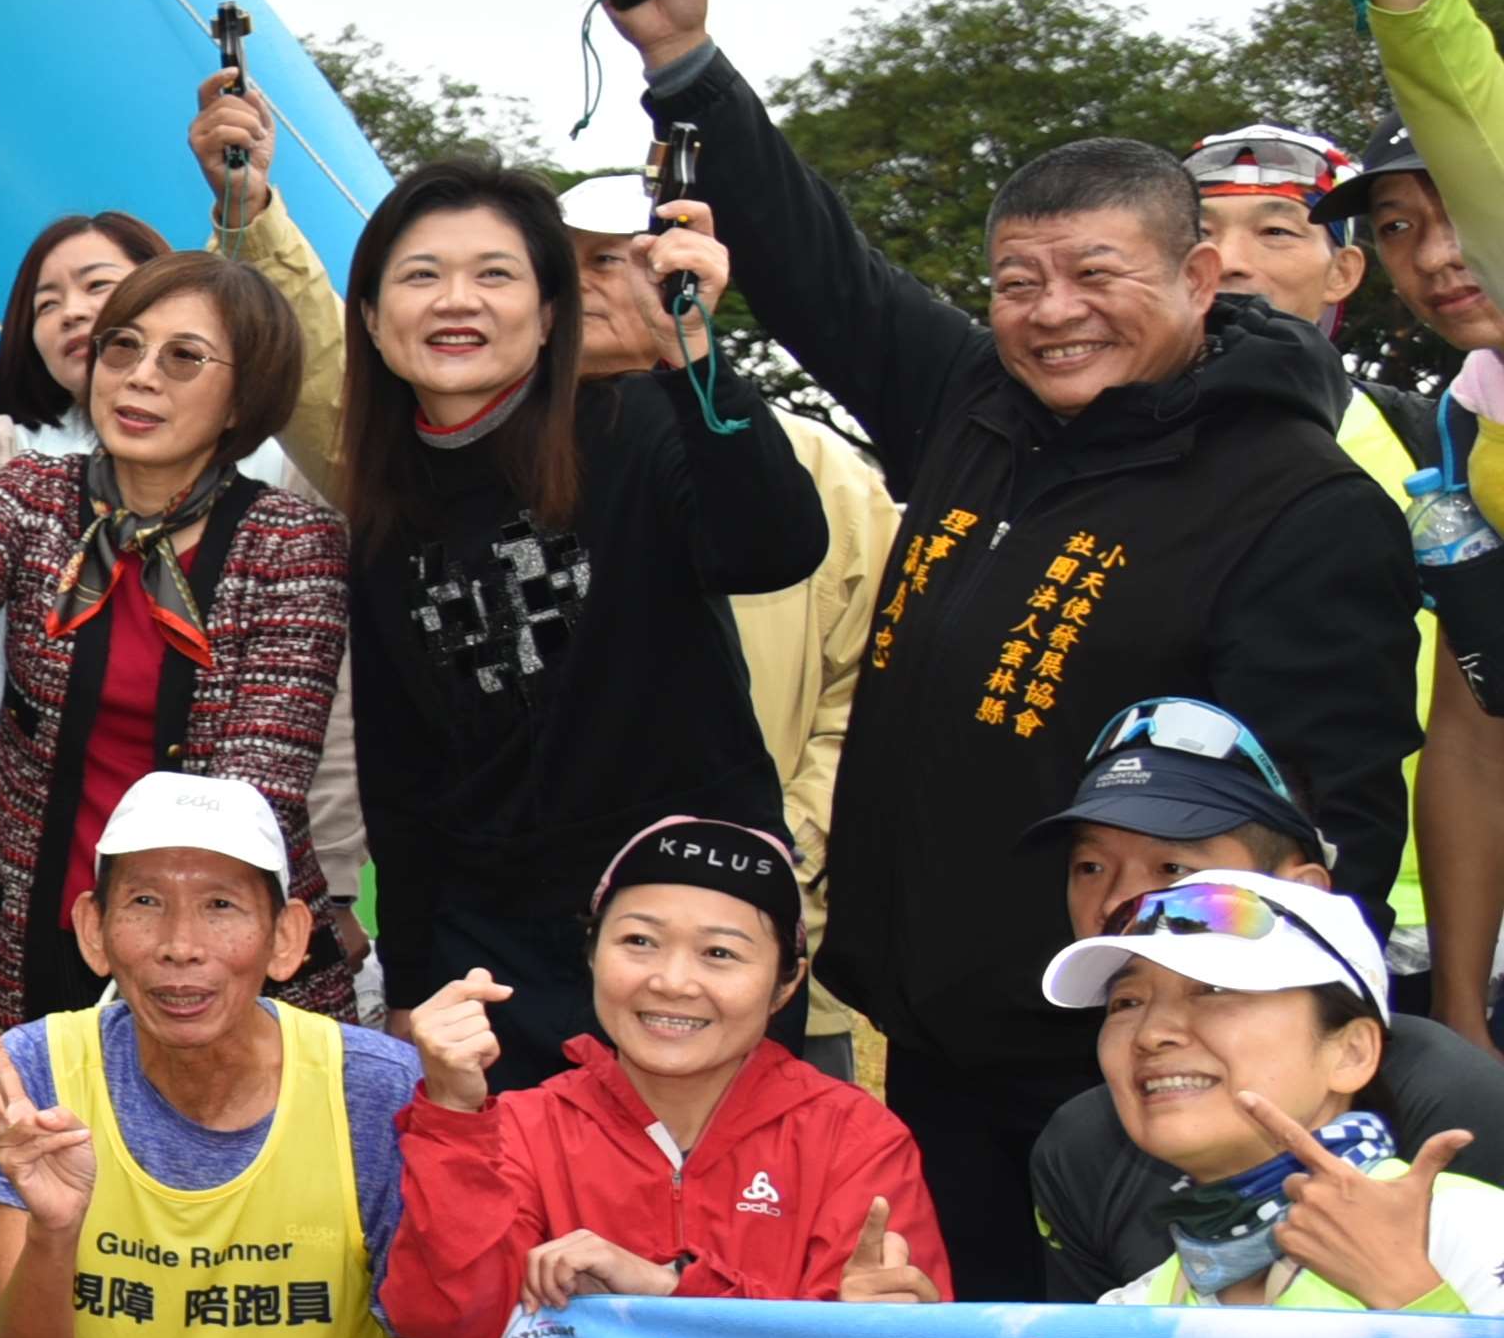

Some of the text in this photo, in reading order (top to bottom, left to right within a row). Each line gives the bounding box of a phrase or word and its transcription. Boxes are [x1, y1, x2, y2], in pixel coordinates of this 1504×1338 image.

[975, 531, 1096, 726] 社團法人雲林縣
[1013, 544, 1126, 739] 小天使發展協會
[659, 837, 773, 876] KPLUS
[96, 1231, 293, 1269] Guide Runner
[184, 1281, 333, 1328] 陪跑員
